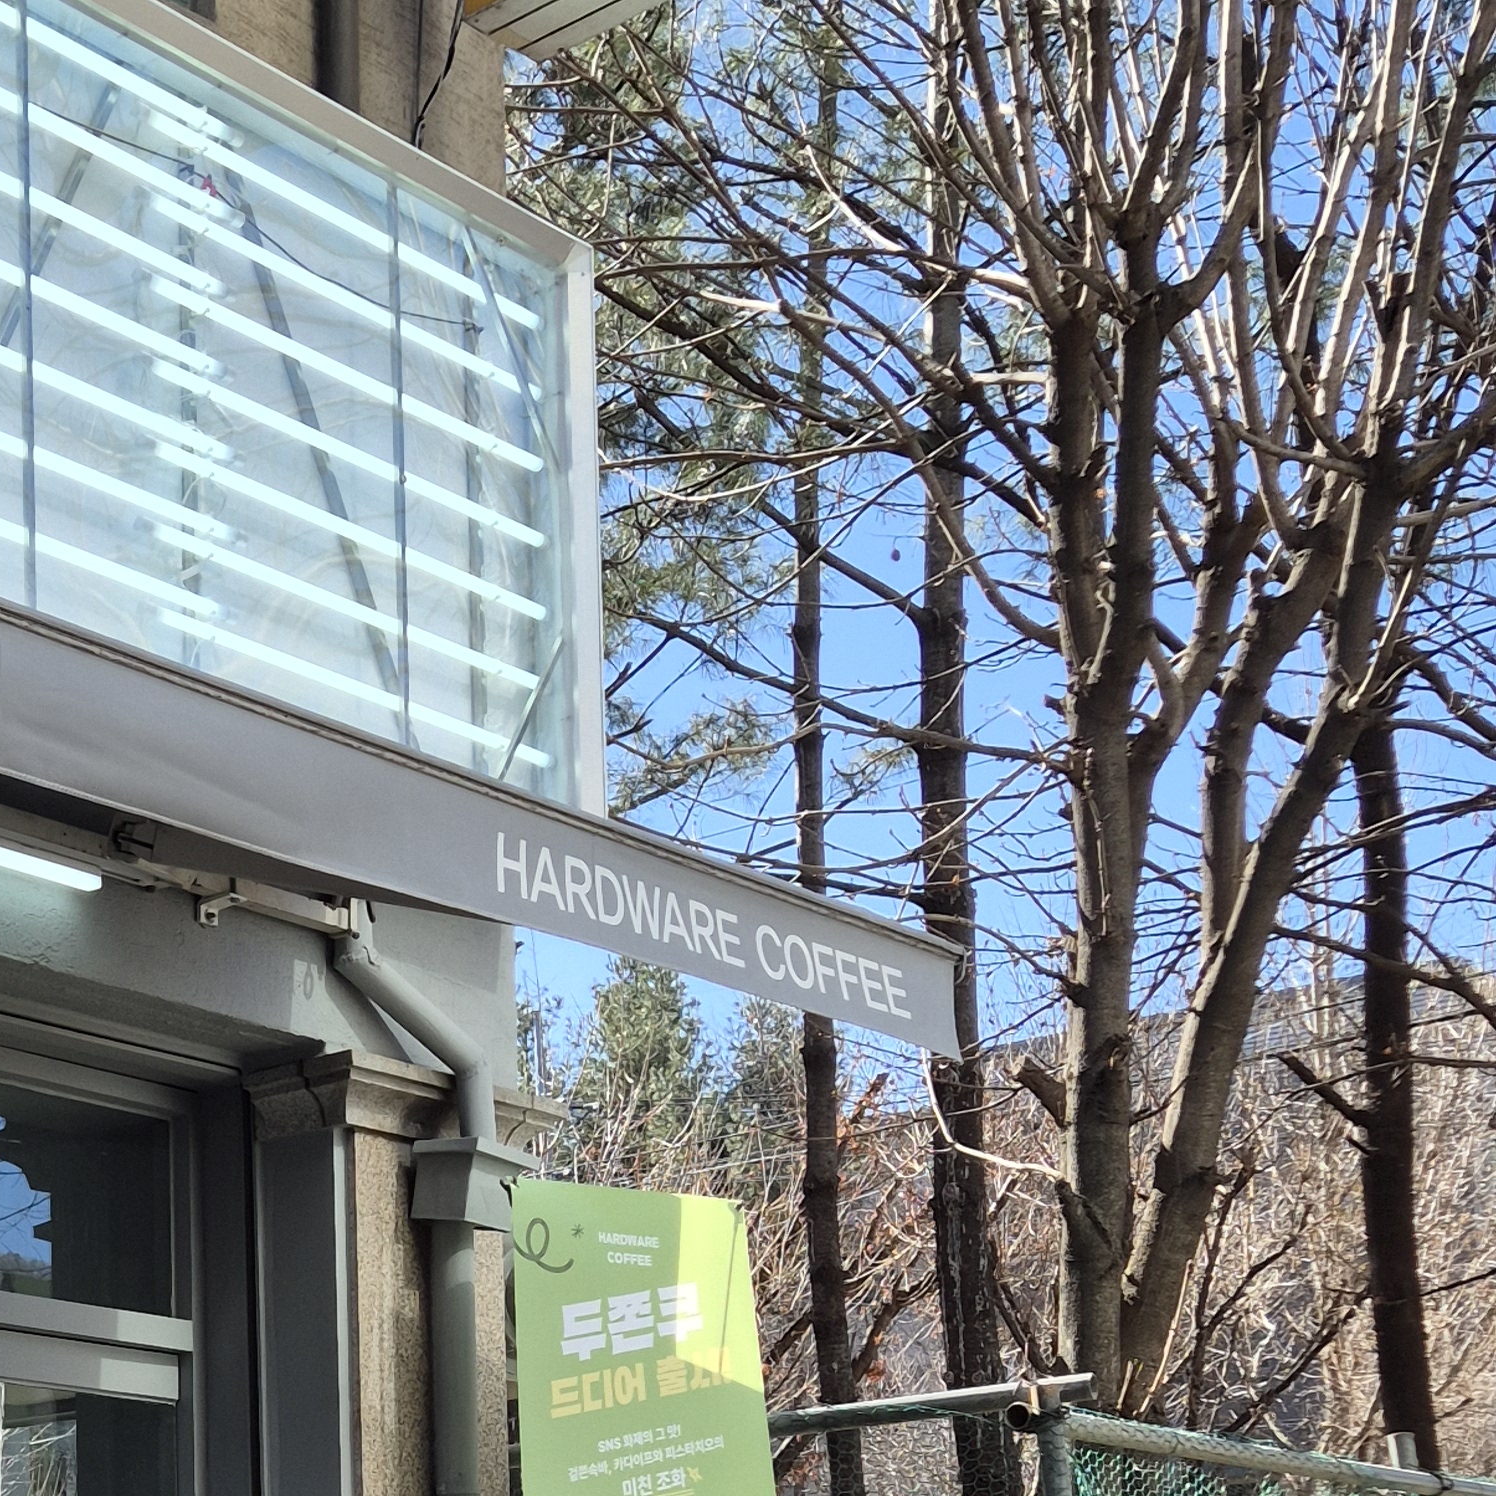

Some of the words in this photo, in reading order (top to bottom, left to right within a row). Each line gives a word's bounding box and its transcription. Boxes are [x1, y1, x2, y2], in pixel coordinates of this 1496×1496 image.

[496, 831, 746, 969] HARDWARE
[755, 924, 912, 1020] COFFEE
[598, 1231, 660, 1249] HARDWARE
[607, 1251, 653, 1267] COFFEE
[560, 1281, 703, 1362] 두쫀쿠
[550, 1362, 647, 1419] 드디어
[597, 1438, 621, 1453] SNS
[622, 1429, 653, 1448] 화제의
[655, 1428, 666, 1440] 그
[613, 1448, 664, 1472] 카다이프와
[665, 1434, 725, 1460] 피스타치오의
[656, 1466, 686, 1491] 조화
